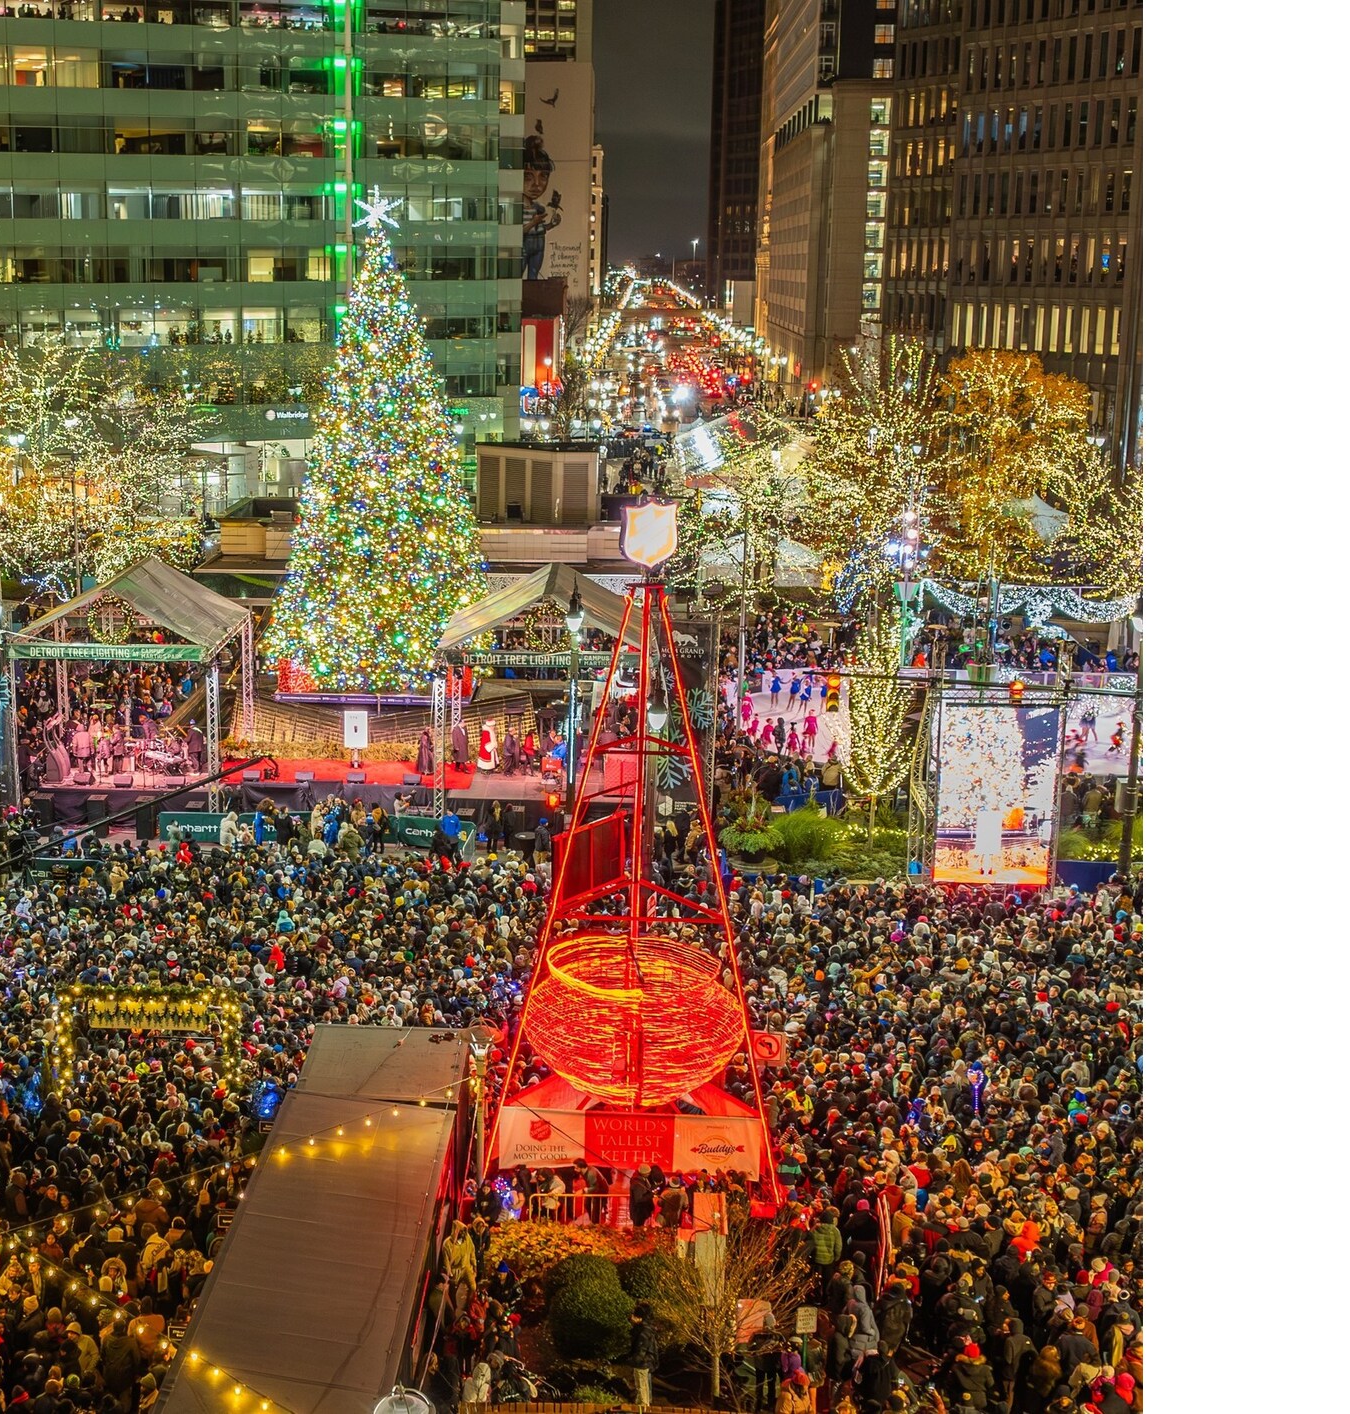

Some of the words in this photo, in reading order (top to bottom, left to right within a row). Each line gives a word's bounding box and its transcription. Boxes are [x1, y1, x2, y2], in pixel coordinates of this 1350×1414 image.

[276, 410, 309, 420] Walbridge
[30, 646, 65, 657] DETROIT
[68, 647, 90, 658] TREE
[91, 647, 130, 659] LIGHTING
[680, 647, 705, 655] GRAND
[463, 654, 502, 665] DETROIT
[503, 654, 528, 665] TREE
[530, 655, 571, 666] LIGHTING
[166, 824, 219, 833] crhartt
[593, 1118, 668, 1133] WORLD'S
[597, 1134, 663, 1148] TALLEST
[515, 1143, 547, 1153] DOING
[550, 1145, 566, 1153] THE
[698, 1143, 736, 1156] Buddy's
[513, 1152, 537, 1160] MOST
[540, 1152, 568, 1161] GOOD
[601, 1150, 659, 1164] KETTLE
